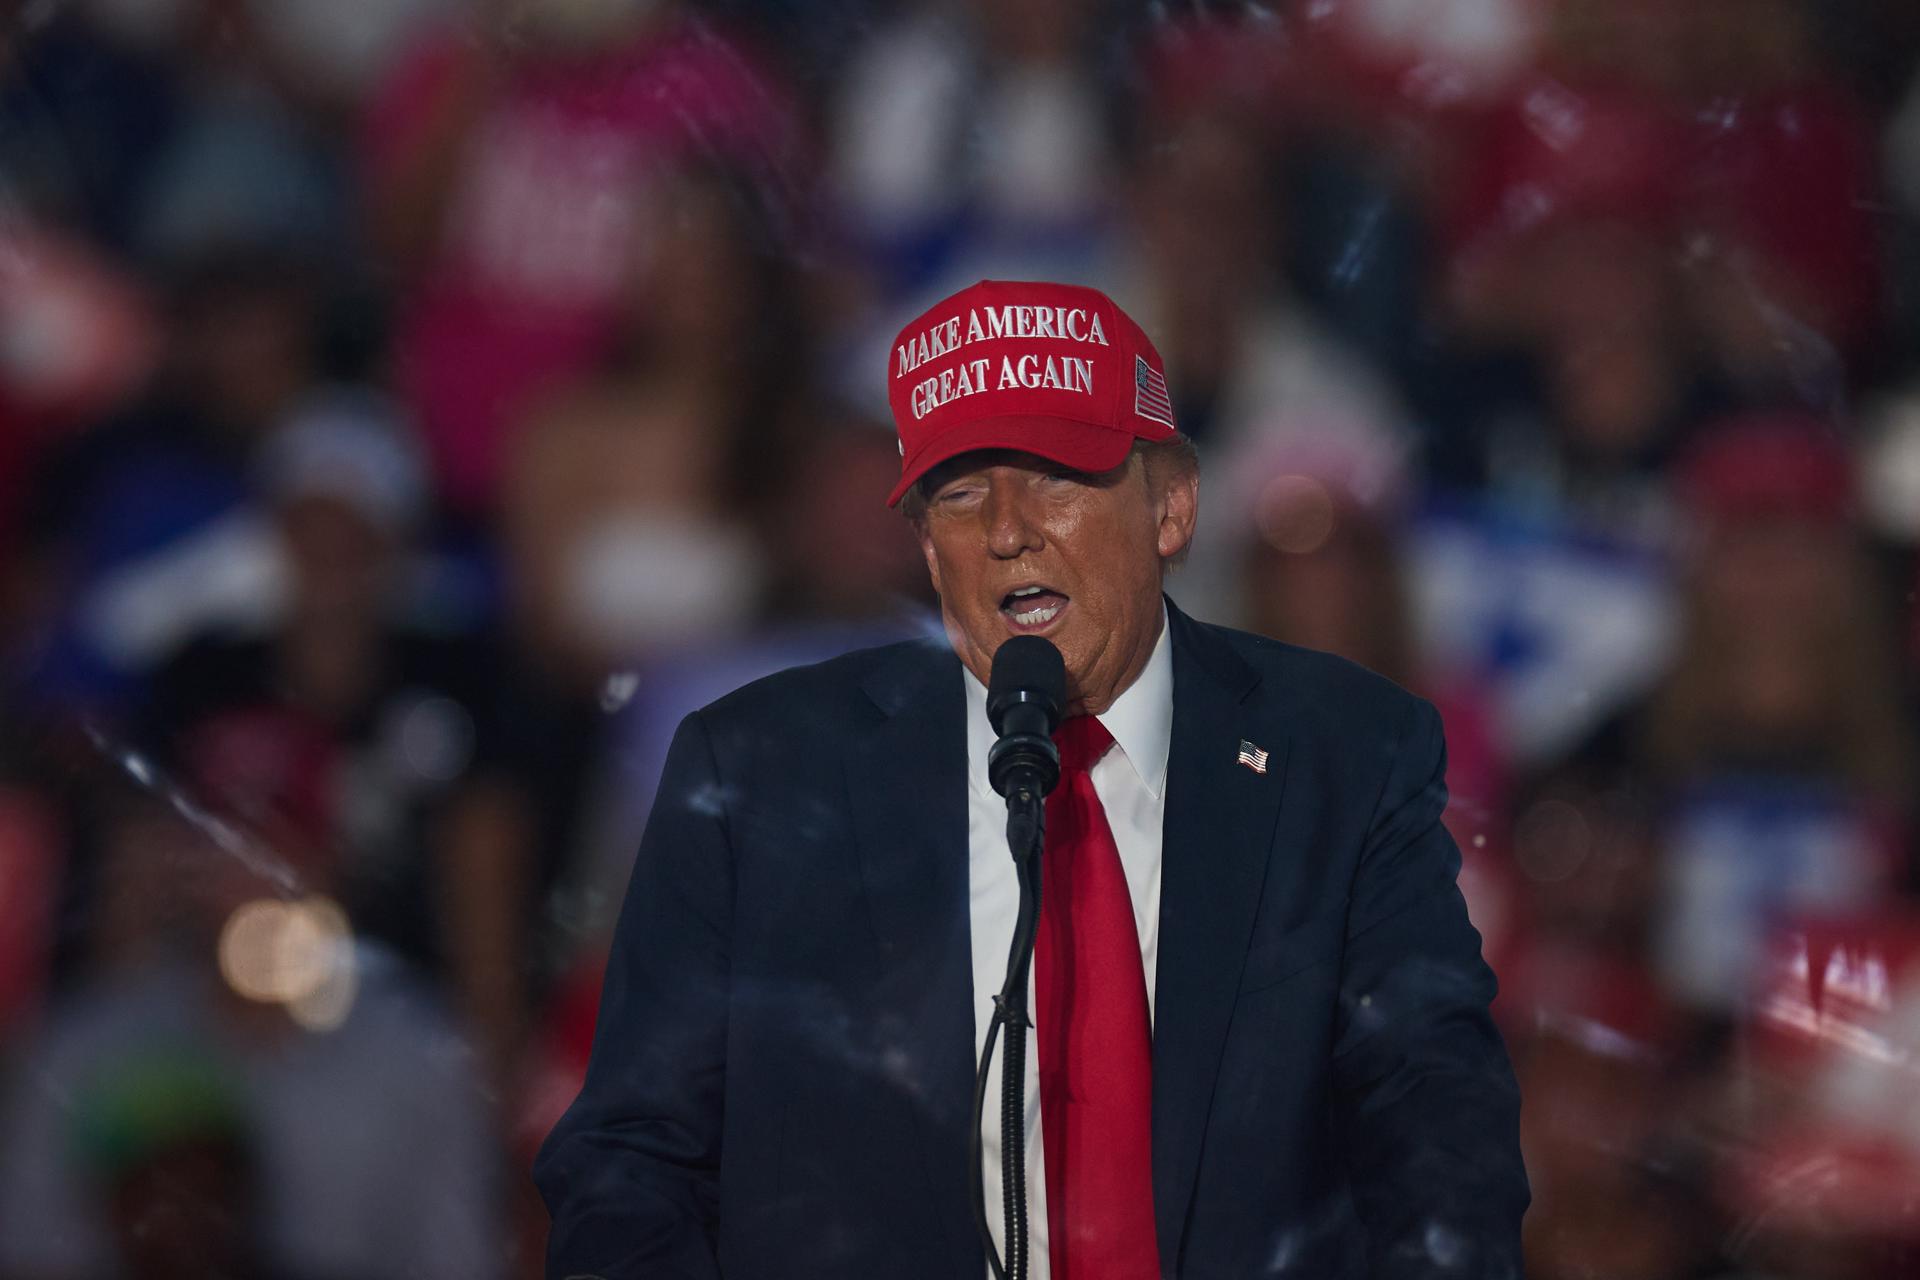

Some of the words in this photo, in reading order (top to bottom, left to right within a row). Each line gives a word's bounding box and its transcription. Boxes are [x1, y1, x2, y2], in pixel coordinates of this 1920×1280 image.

[897, 316, 962, 378] MAKE
[965, 306, 1109, 346] AMERICA
[911, 359, 990, 420] GREAT
[997, 355, 1094, 396] AGAIN
